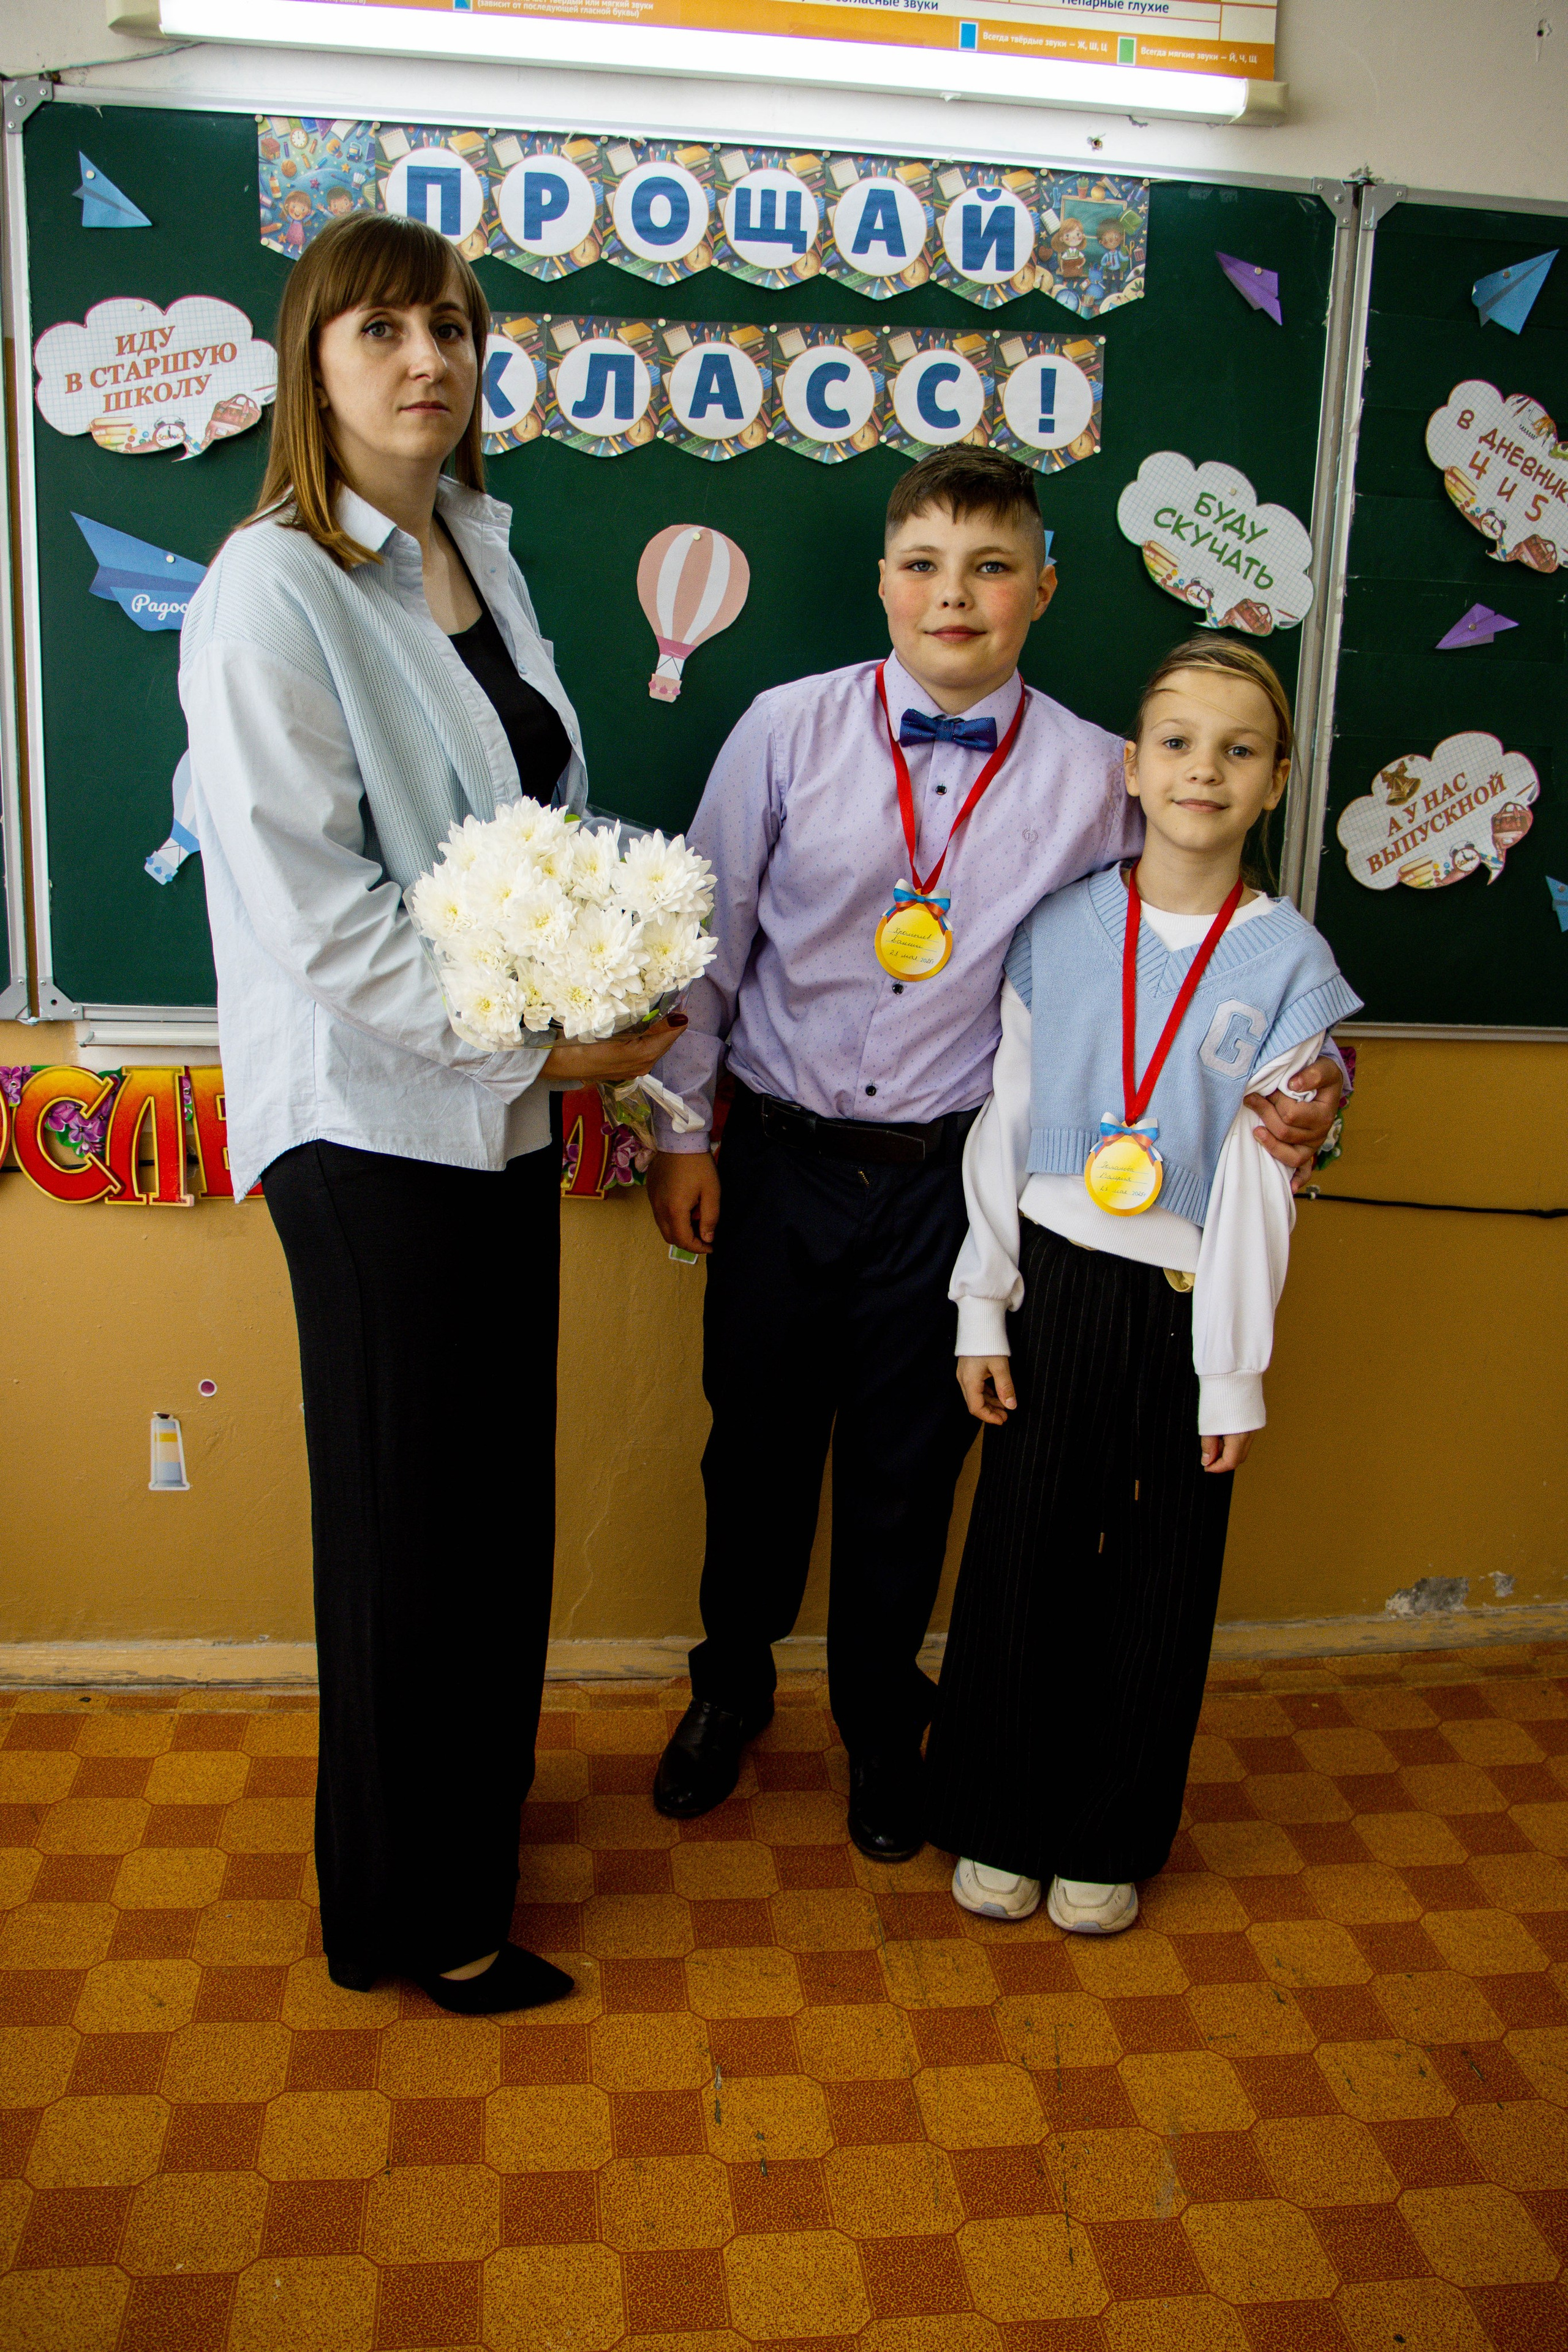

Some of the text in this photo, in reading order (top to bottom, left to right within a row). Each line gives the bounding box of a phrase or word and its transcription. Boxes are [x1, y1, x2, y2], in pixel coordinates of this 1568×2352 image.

[523, 2, 578, 13] последующей
[613, 8, 639, 18] буквы)
[631, 2, 654, 10] звуки
[903, 0, 939, 12] звуки
[1128, 1, 1169, 13] глухие
[982, 31, 1009, 42] Всегда
[1011, 35, 1043, 45] твёрдые
[1045, 39, 1066, 48] звуки
[1140, 47, 1166, 56] Всегда
[1168, 50, 1195, 59] мягкие
[1197, 52, 1218, 61] звуки
[405, 165, 1016, 273] ПРОЩАЙ
[115, 325, 176, 356] ИДУ
[65, 342, 238, 394] В СТАРШУЮ
[103, 374, 213, 413] ШКОЛУ
[1457, 409, 1568, 508] В ДНЕВНИК
[1469, 451, 1549, 522] 4 И 5
[1194, 492, 1268, 545] БУДУ
[1153, 508, 1273, 589] СКУЧАТЬ
[1366, 771, 1507, 875] ВЫПУСКНОЙ
[1387, 772, 1468, 837] А У НАС
[1198, 997, 1269, 1081] G
